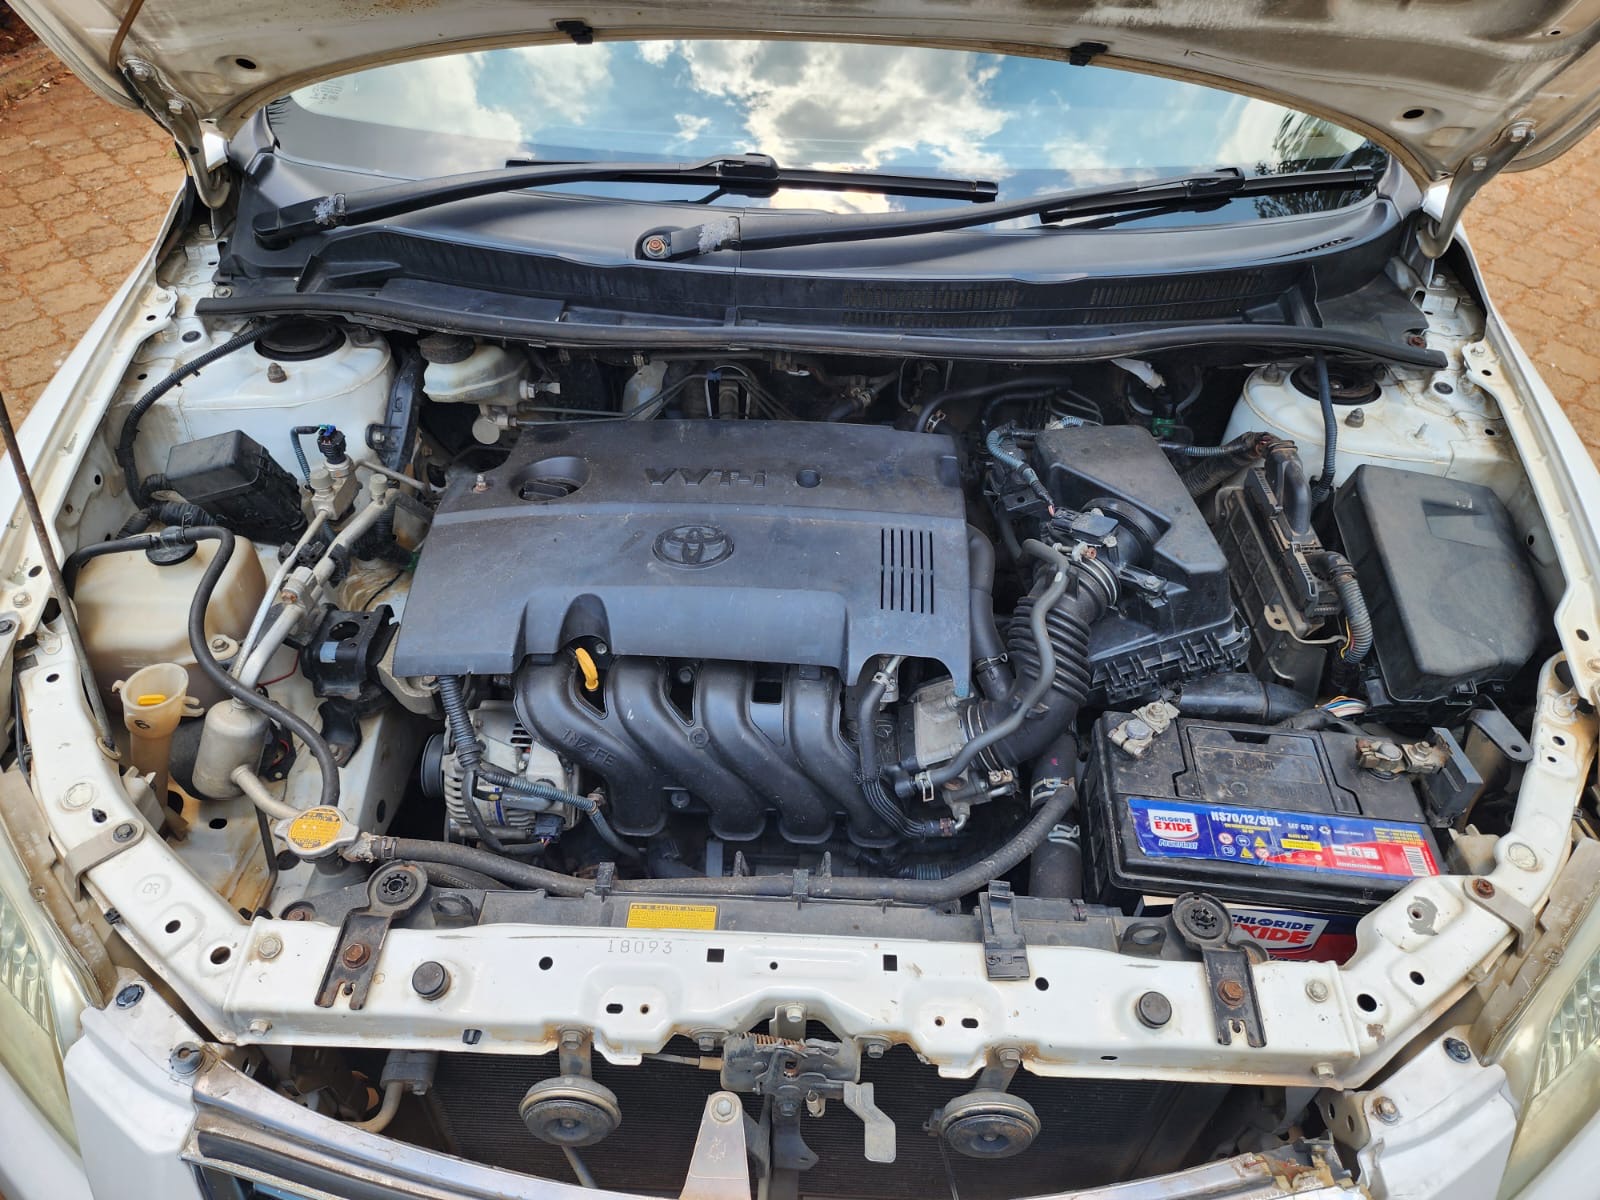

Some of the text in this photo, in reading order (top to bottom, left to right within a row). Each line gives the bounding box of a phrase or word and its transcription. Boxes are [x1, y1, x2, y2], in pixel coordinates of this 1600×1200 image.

[1154, 815, 1192, 824] CHLORIDE
[1154, 821, 1193, 832] EXIDE
[1233, 923, 1312, 944] XIDE
[607, 938, 673, 954] 18093
